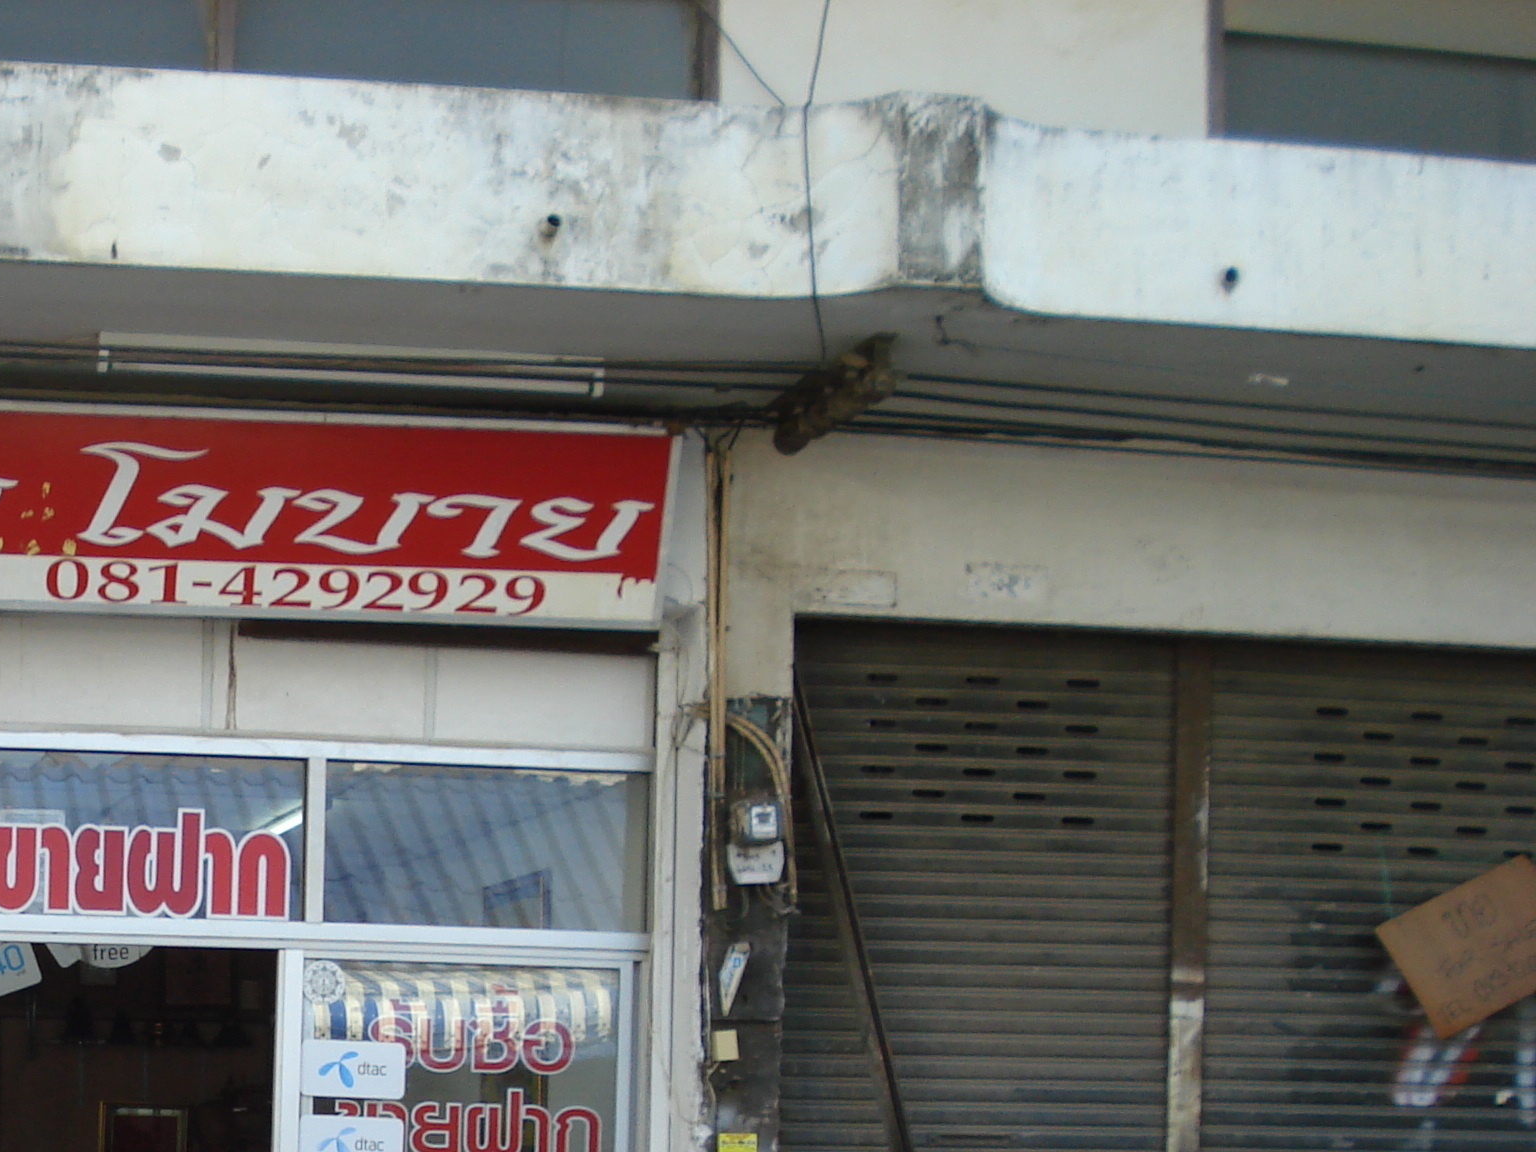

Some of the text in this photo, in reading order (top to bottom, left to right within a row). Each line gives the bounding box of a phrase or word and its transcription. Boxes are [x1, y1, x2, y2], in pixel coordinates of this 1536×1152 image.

[76, 440, 655, 562] โมบาย
[45, 558, 546, 617] 081-4292929
[93, 944, 129, 960] free
[368, 984, 576, 1075] รับซื้อ
[357, 1058, 387, 1077] dtac
[354, 1136, 384, 1152] dtac
